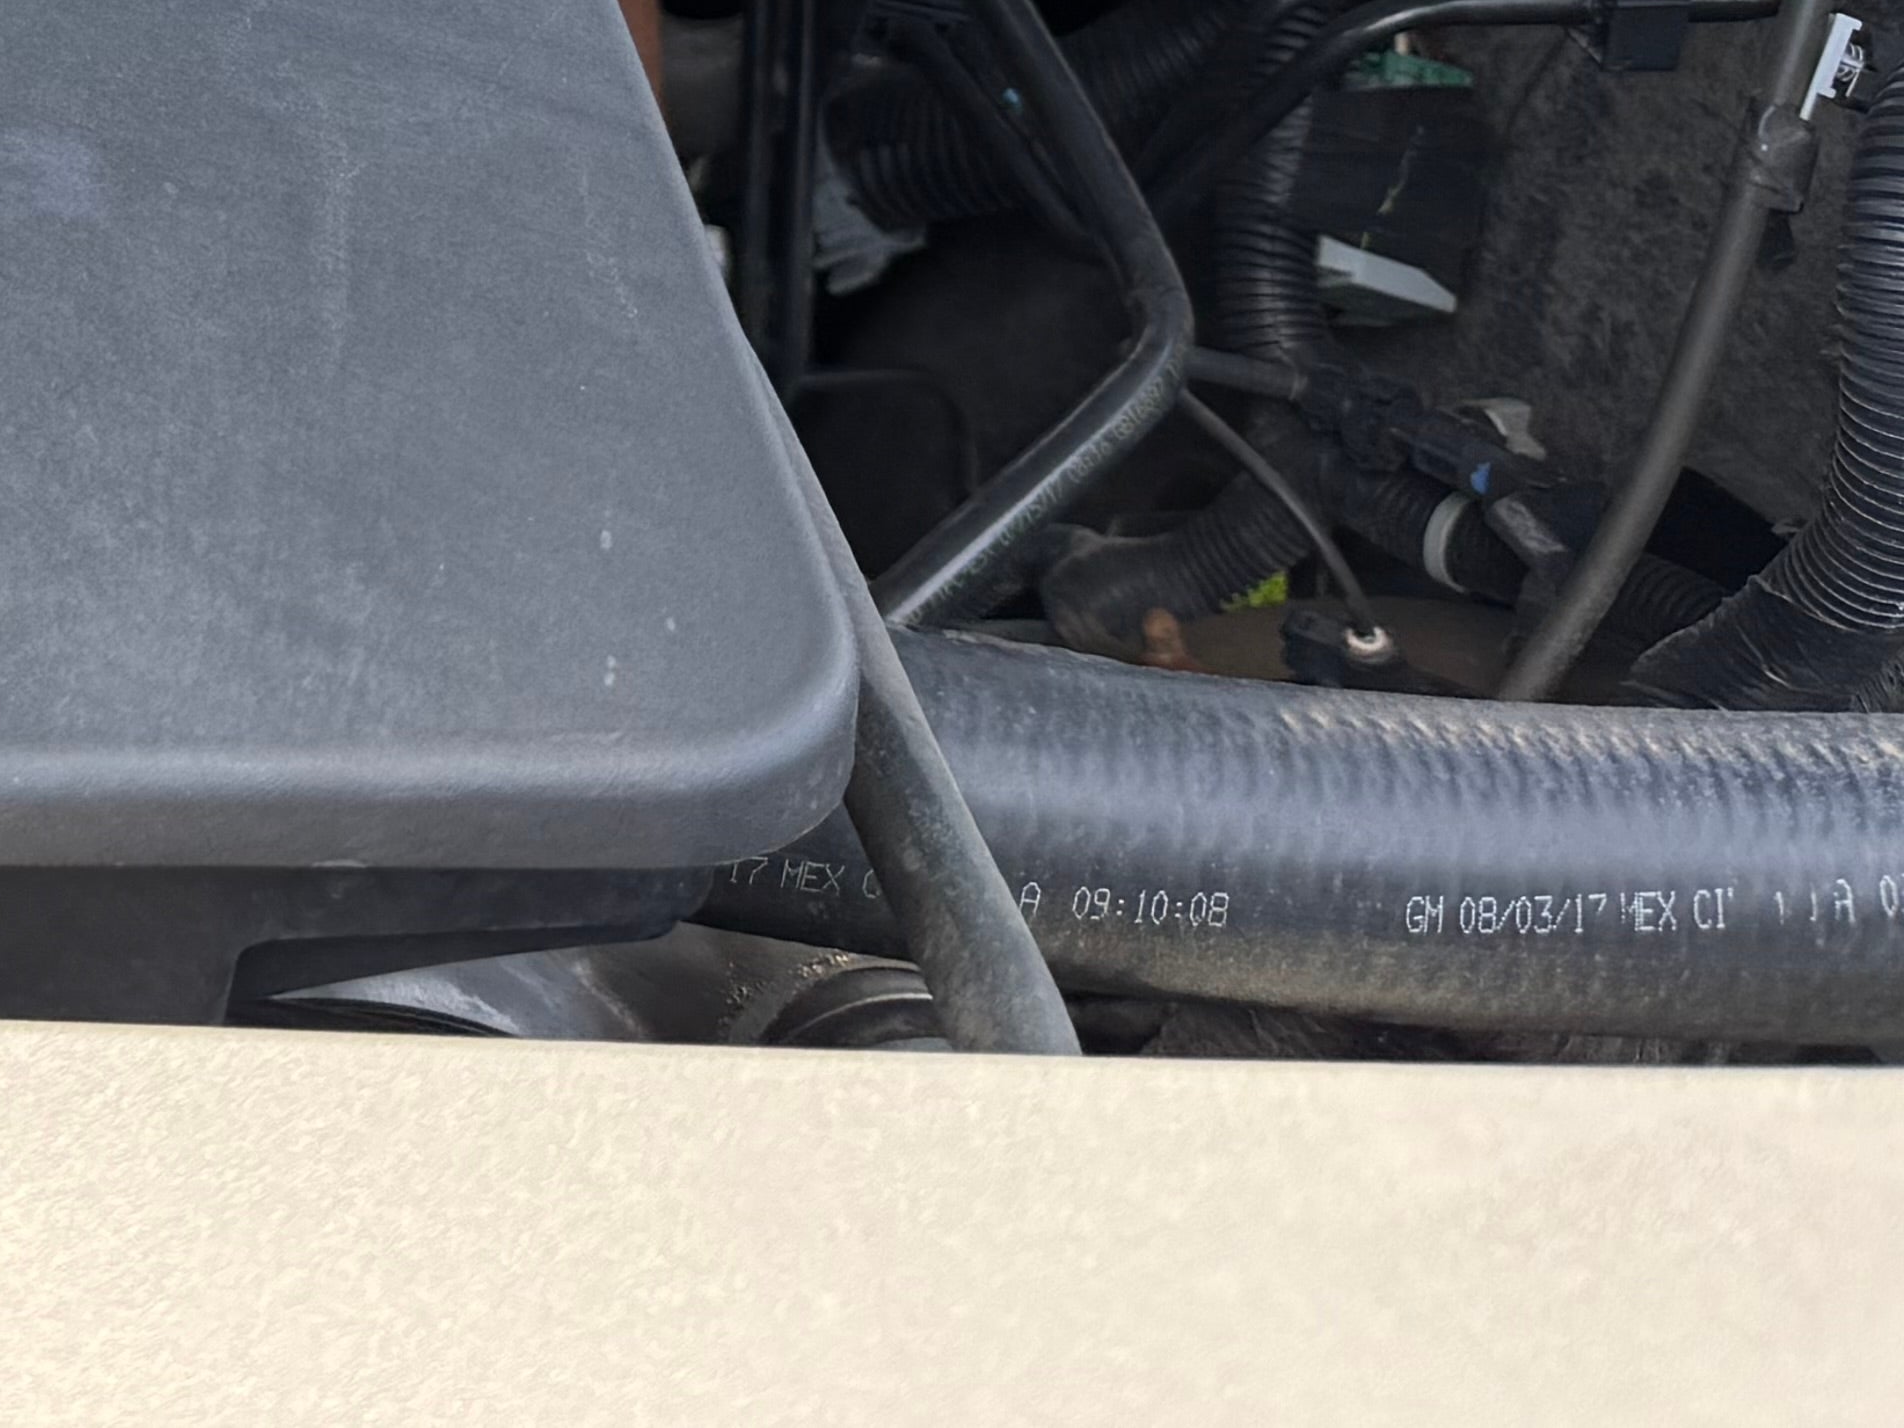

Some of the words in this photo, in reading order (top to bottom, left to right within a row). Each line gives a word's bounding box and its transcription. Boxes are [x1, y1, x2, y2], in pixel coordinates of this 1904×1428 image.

[780, 858, 846, 896] MEX
[1072, 885, 1230, 928] 09:10:08
[1406, 894, 1444, 934] GM
[1459, 892, 1607, 934] 08/03/17
